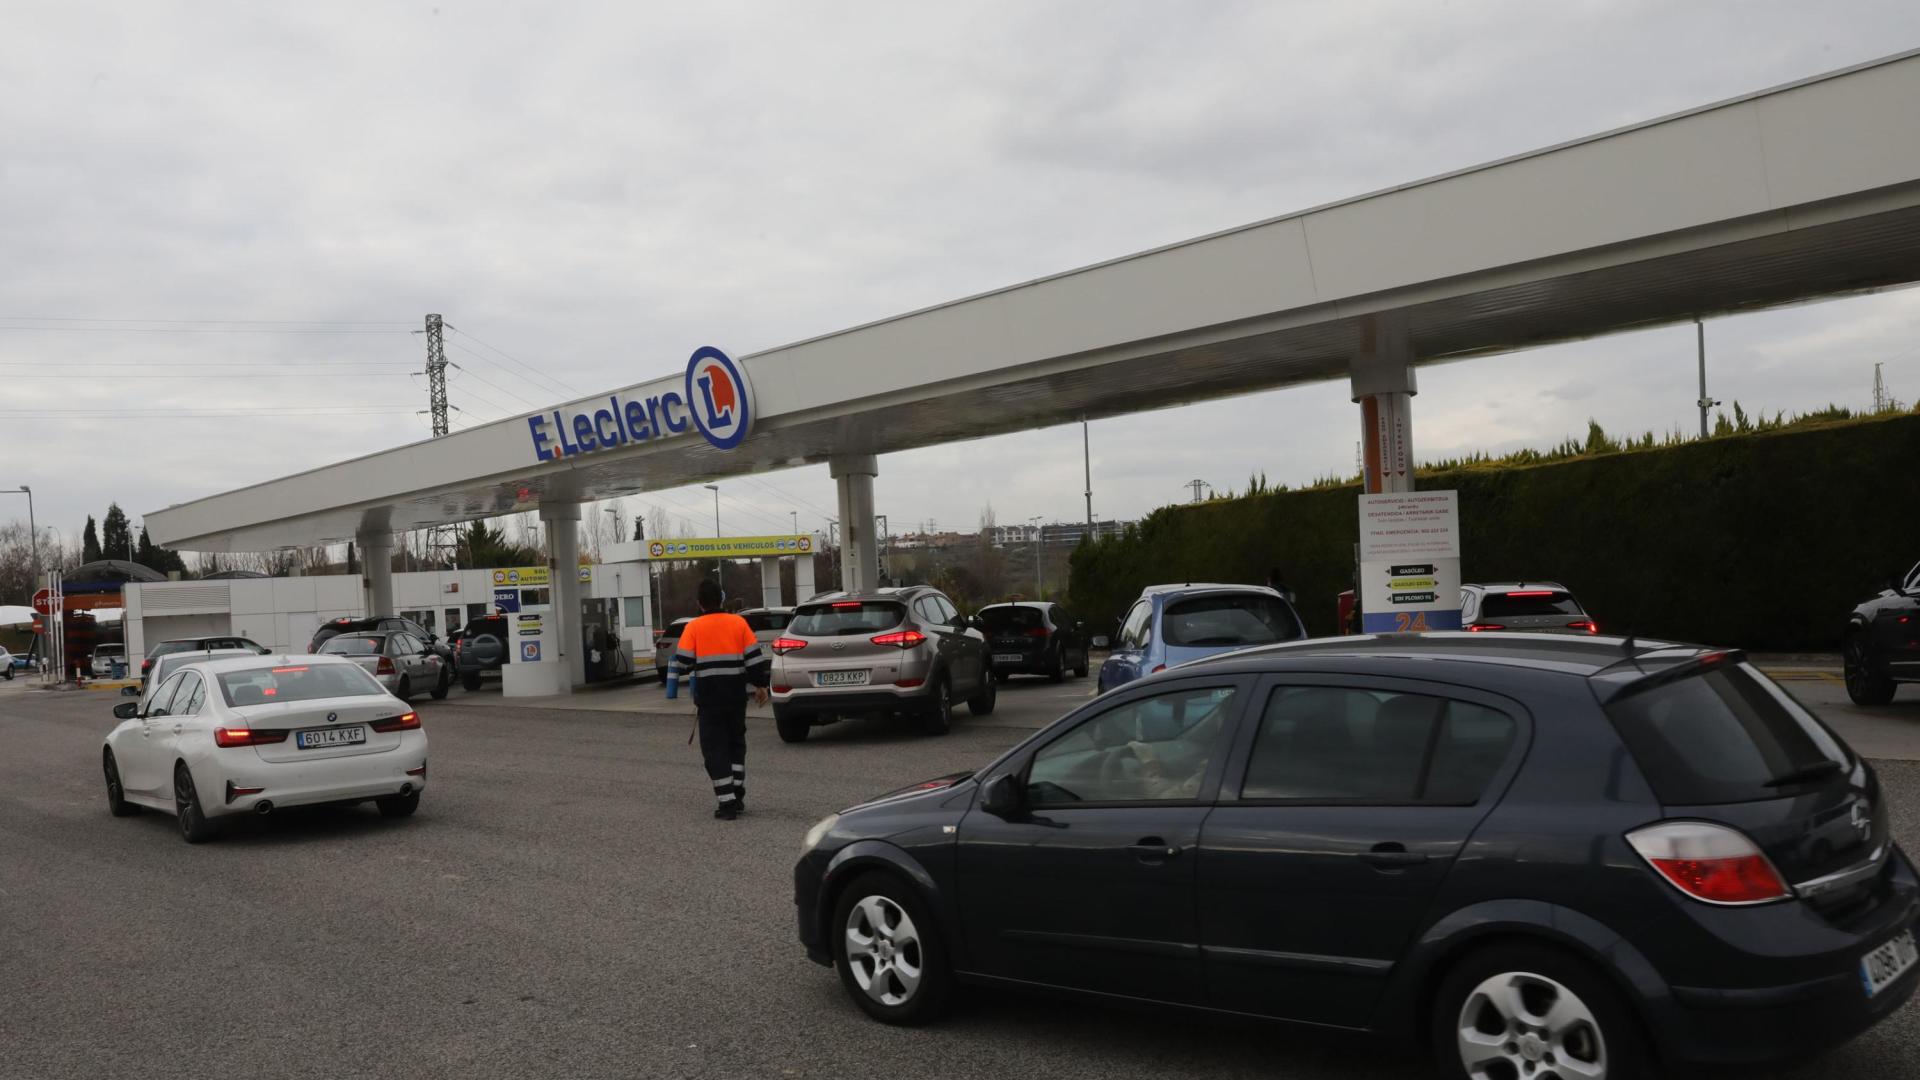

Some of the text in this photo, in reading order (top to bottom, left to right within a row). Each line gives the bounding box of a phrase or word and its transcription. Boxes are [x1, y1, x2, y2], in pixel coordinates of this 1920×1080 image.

[527, 391, 687, 461] E.Leclerc
[690, 543, 715, 551] TODOS
[823, 671, 864, 681] 0823 KKP
[305, 729, 360, 744] 6014 KXF
